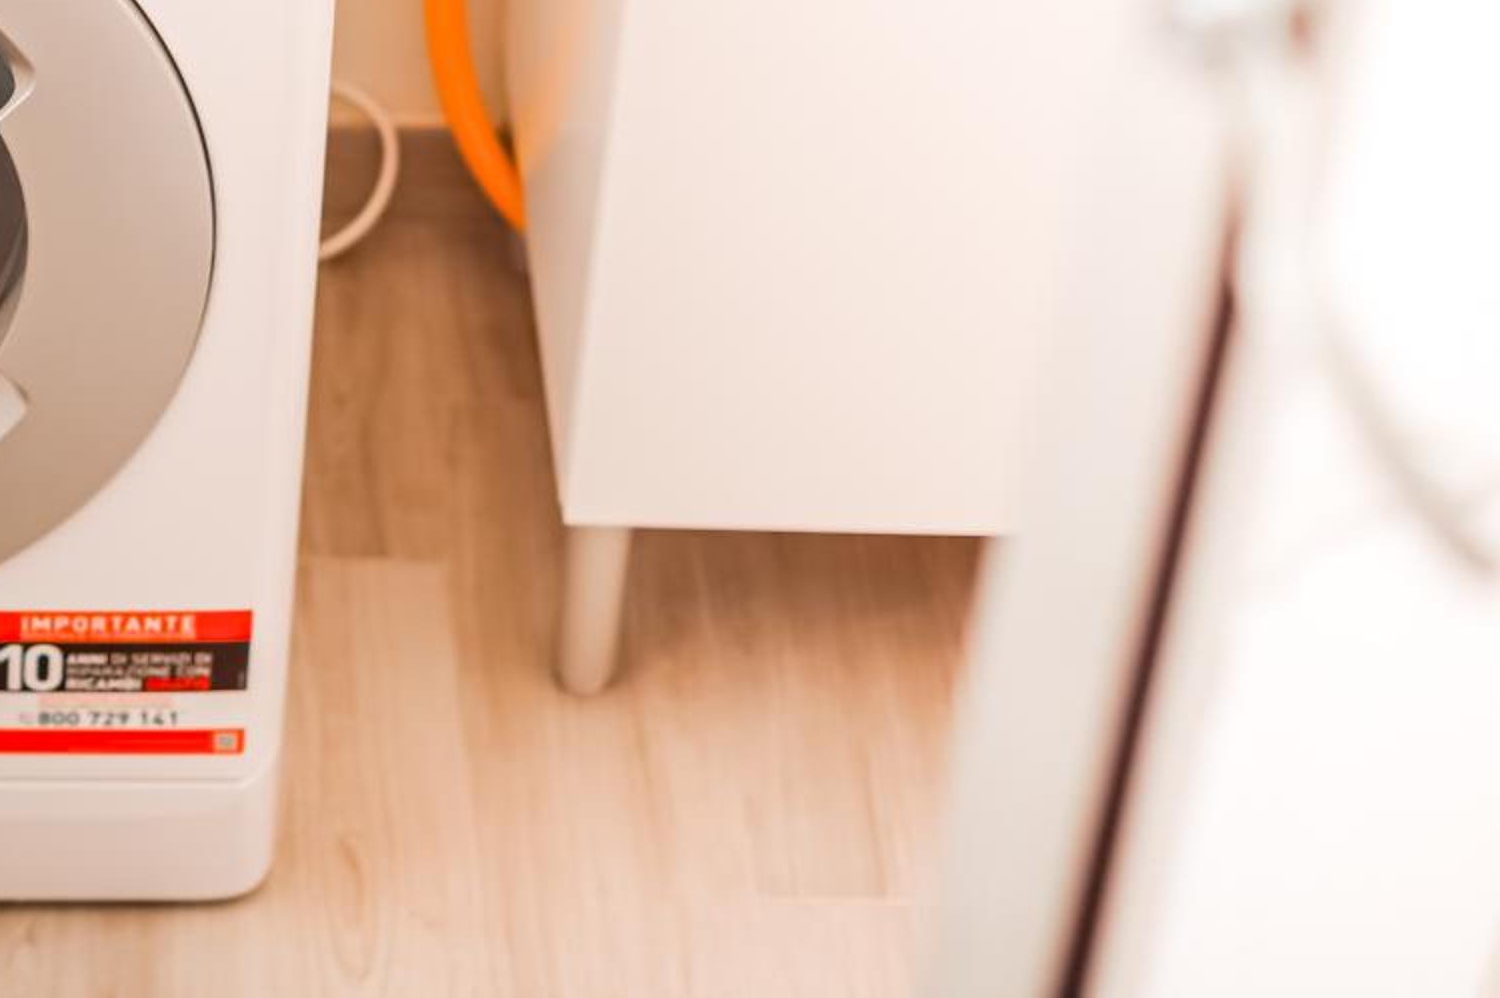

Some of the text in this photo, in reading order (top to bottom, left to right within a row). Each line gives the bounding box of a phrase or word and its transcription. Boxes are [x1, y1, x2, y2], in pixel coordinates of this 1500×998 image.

[21, 614, 196, 633] IMPORTANTE
[38, 710, 179, 726] 800 729 141
